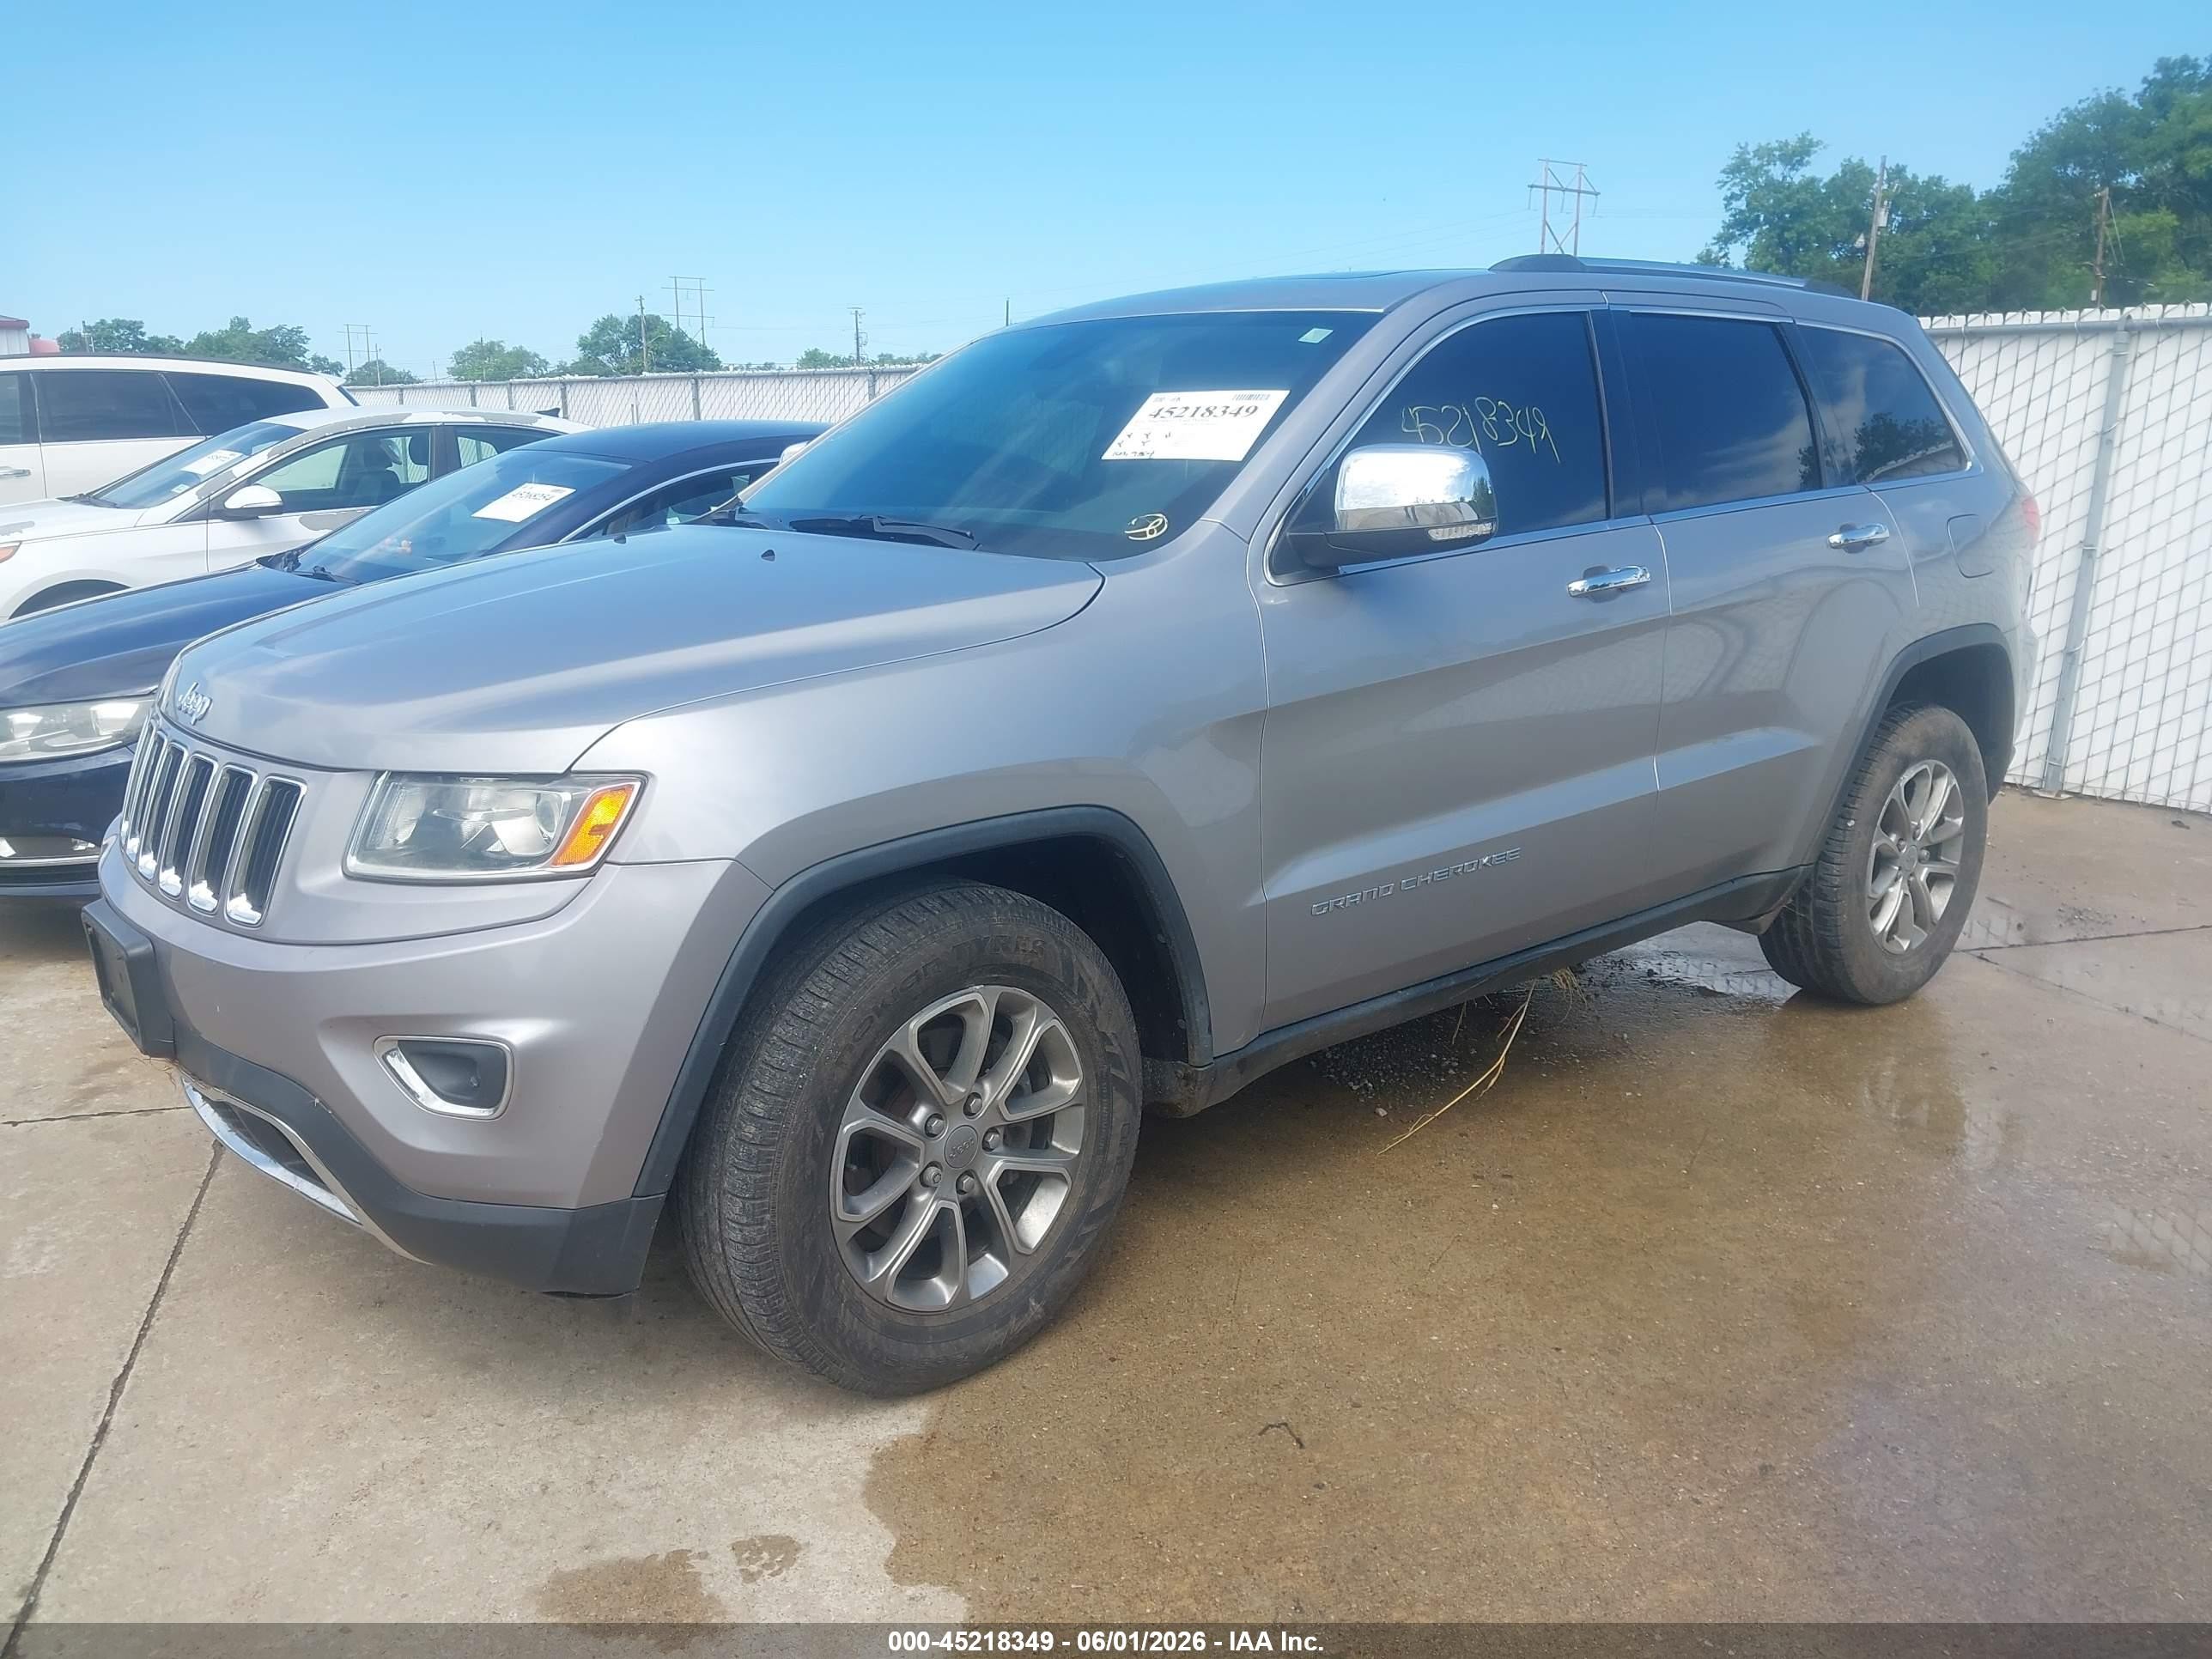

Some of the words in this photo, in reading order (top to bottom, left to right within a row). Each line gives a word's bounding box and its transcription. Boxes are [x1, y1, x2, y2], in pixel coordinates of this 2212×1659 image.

[1148, 404, 1259, 420] 45218349
[1401, 396, 1561, 464] 45218349
[178, 682, 213, 726] Jeep
[1311, 883, 1395, 916] GRAND
[1401, 847, 1522, 891] CHEROKEE
